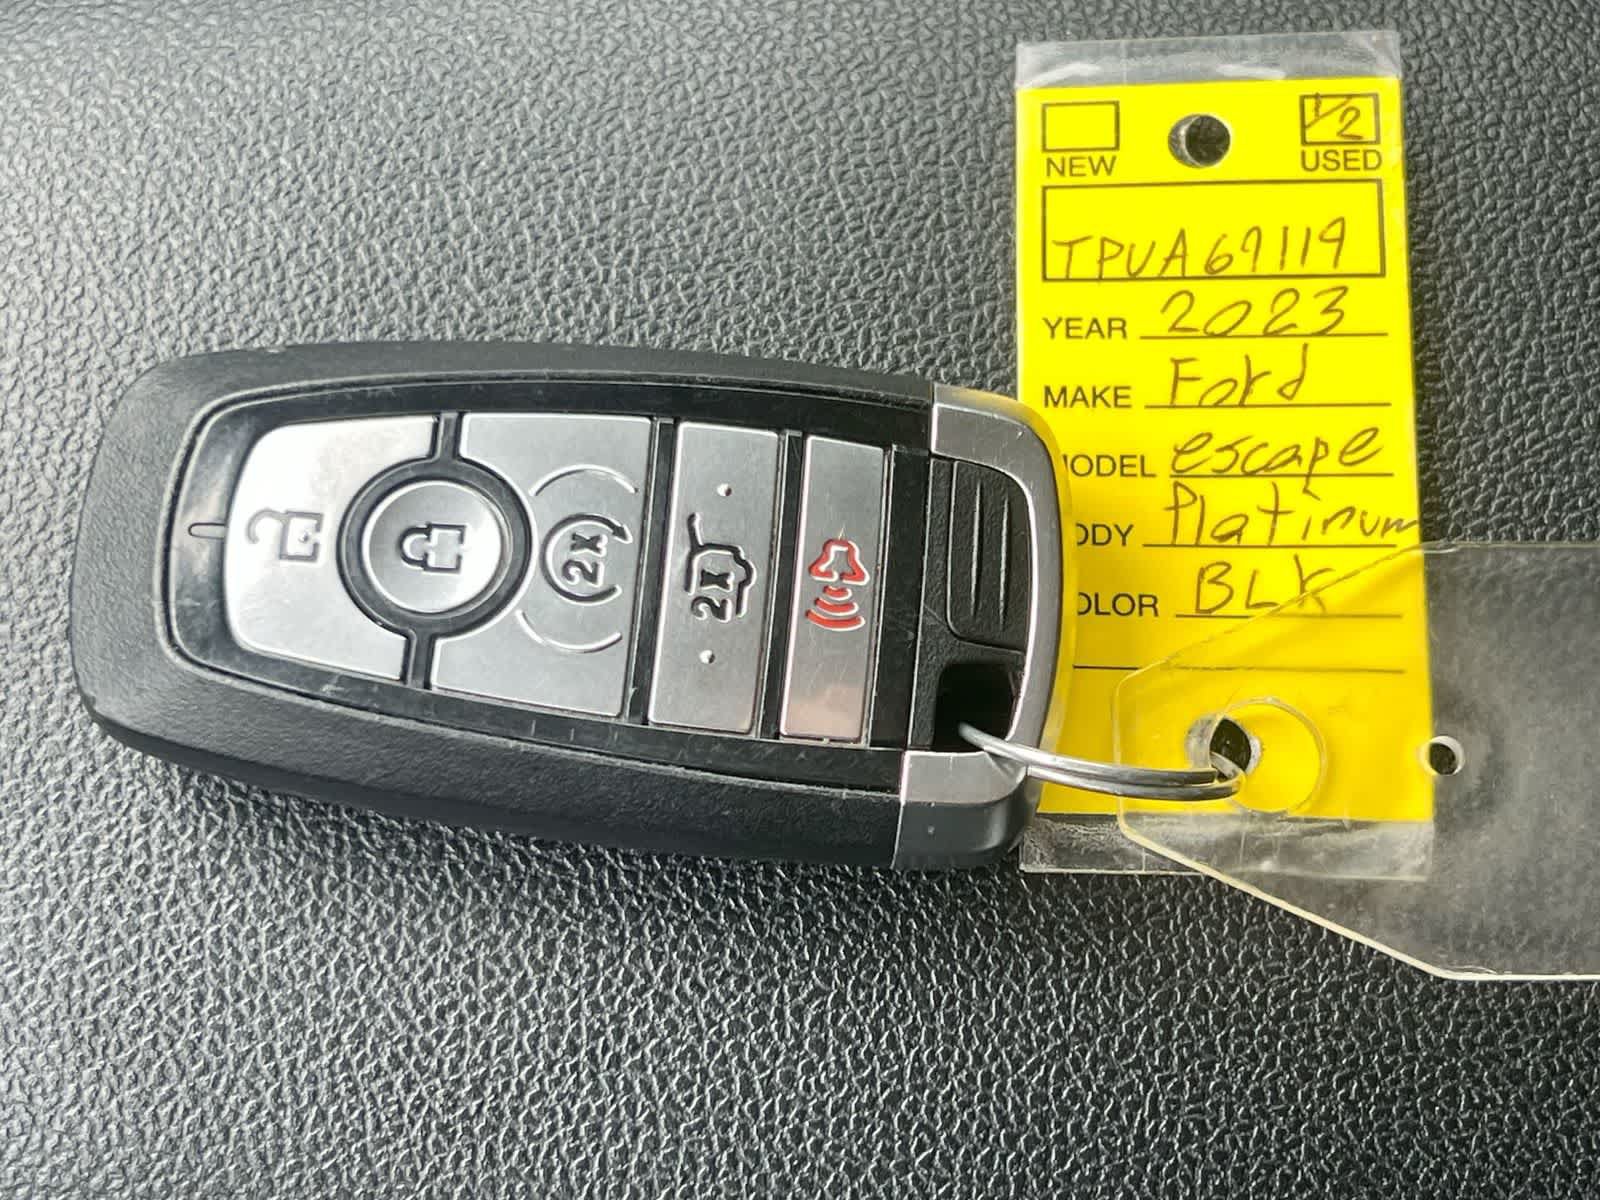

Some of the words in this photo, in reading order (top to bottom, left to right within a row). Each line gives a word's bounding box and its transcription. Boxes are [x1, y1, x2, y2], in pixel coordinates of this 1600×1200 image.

[1045, 156, 1117, 177] NEW
[1300, 149, 1382, 172] USED
[1161, 286, 1348, 336] 2023
[1043, 317, 1128, 339] YEAR
[1170, 343, 1309, 407] Ford
[1044, 386, 1132, 408] MAKE
[1063, 454, 1157, 477] ODEL
[1164, 481, 1418, 545] Platinum
[1076, 523, 1134, 546] ODY
[1077, 592, 1159, 617] OLOR
